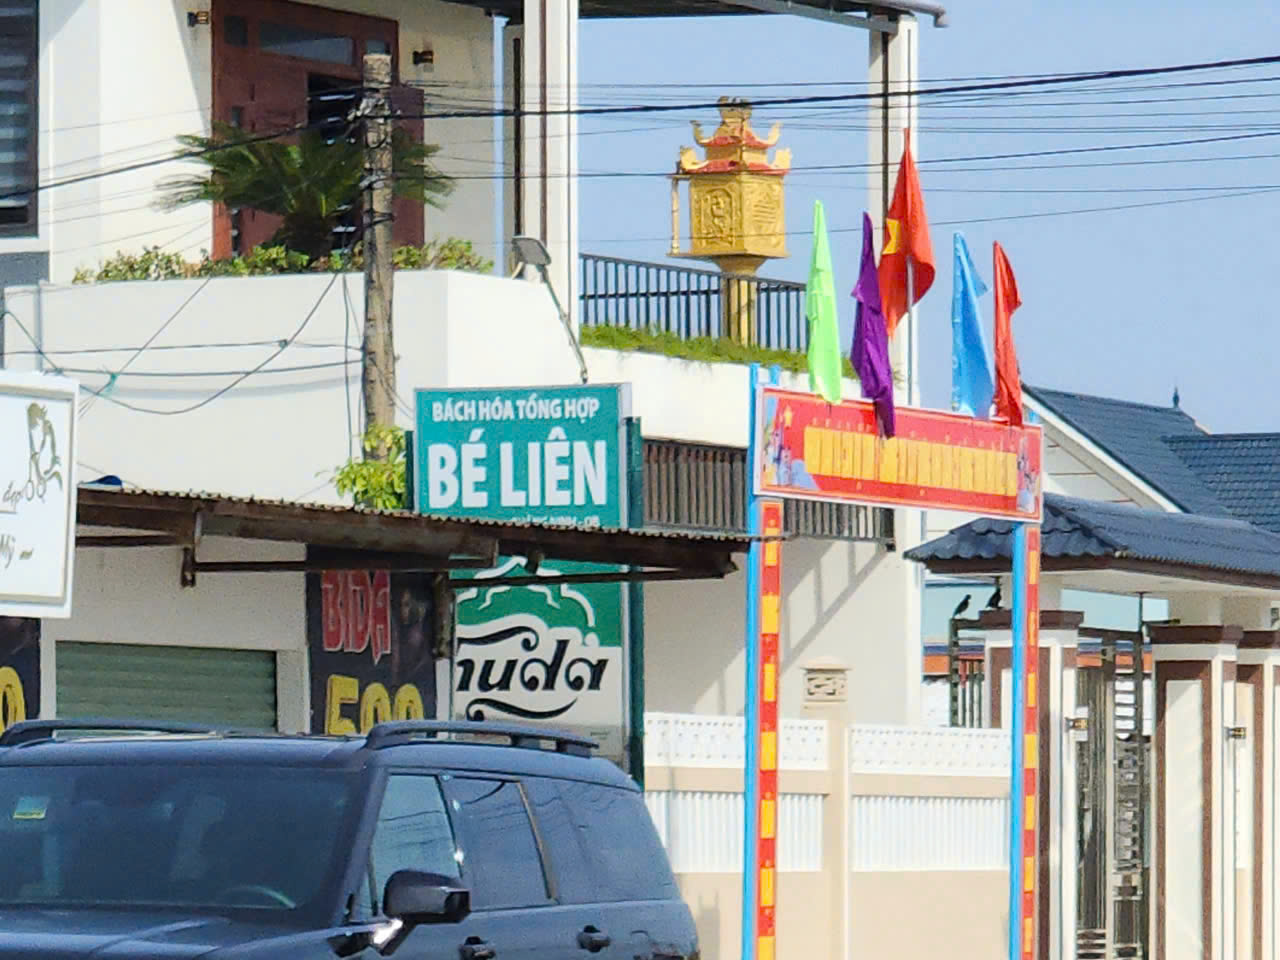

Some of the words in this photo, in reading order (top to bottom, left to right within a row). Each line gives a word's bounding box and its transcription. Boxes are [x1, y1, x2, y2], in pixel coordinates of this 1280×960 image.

[432, 397, 476, 422] BÁCH
[478, 396, 515, 421] HÓA
[564, 397, 600, 424] HỢP
[427, 428, 488, 509] BÉ
[500, 426, 607, 507] LIÊN
